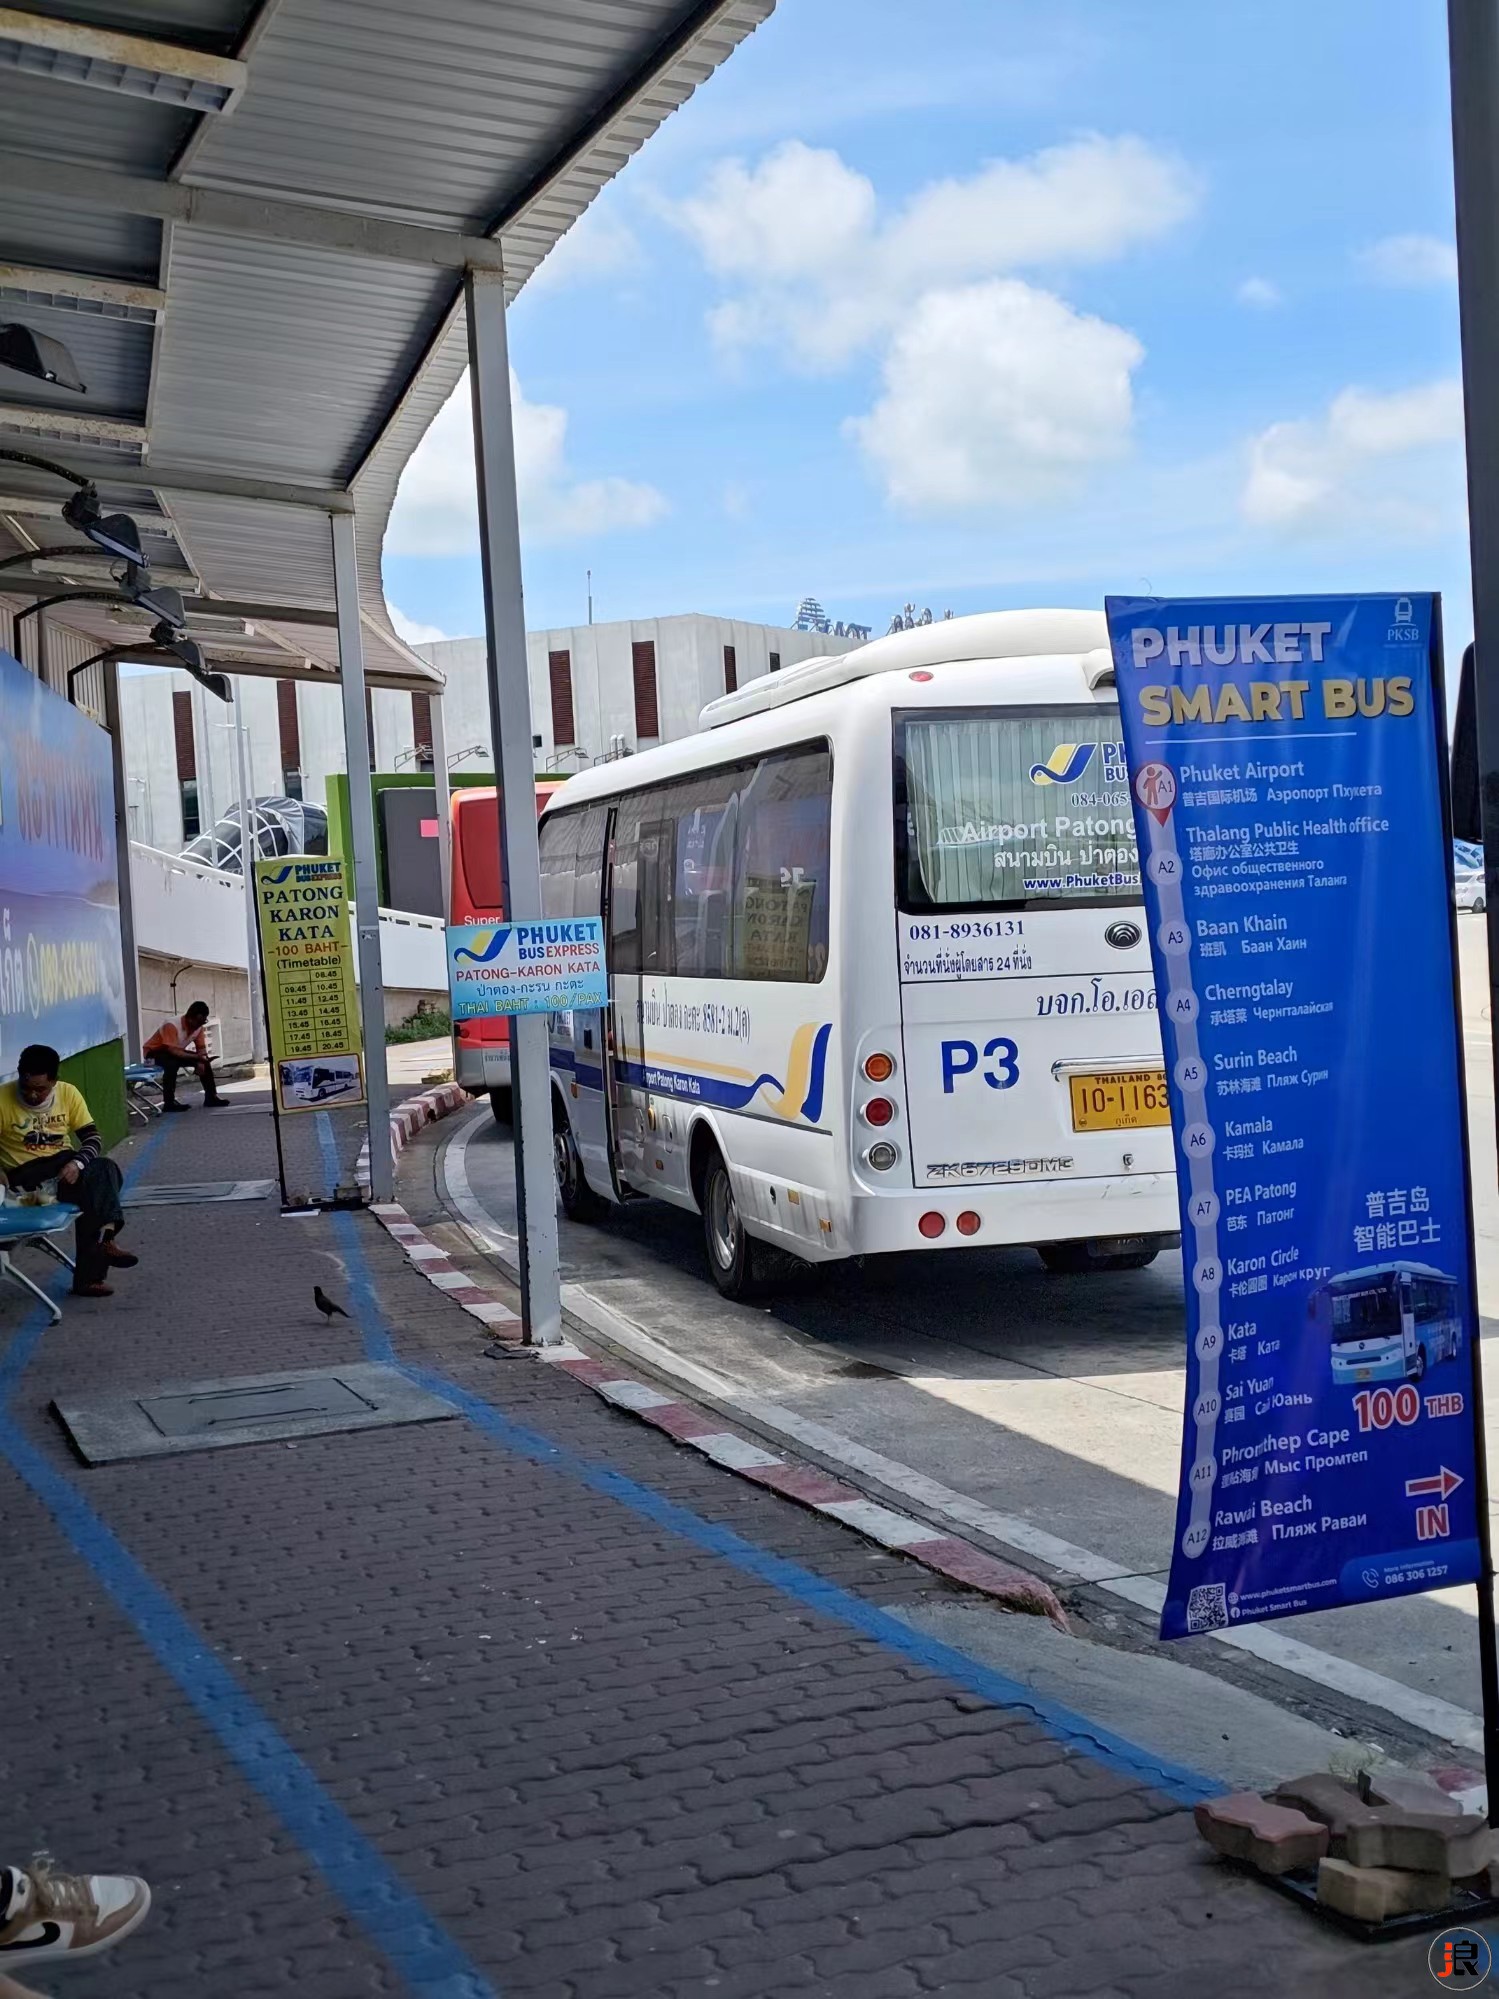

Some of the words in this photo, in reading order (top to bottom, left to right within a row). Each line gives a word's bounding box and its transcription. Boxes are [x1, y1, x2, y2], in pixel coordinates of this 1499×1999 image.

[1387, 628, 1419, 641] PKSB
[1130, 622, 1332, 668] PHUKET
[1138, 680, 1311, 726] SMART
[1322, 676, 1415, 718] BUS
[1180, 764, 1240, 783] Phuket
[1245, 761, 1305, 783] Airport
[1158, 780, 1173, 793] A1
[1182, 788, 1258, 807] 普吉国际机场
[1267, 786, 1329, 804] Аэропорт
[1332, 783, 1383, 801] Пхукета
[962, 818, 1048, 845] Airport
[1186, 825, 1250, 844] Thalang
[1254, 820, 1299, 838] Public
[1302, 818, 1348, 835] Health
[1349, 817, 1390, 833] office
[993, 843, 1072, 869] สนามบิน
[294, 862, 341, 875] PHUKET
[1158, 860, 1175, 874] A2
[1191, 864, 1229, 880] Офис
[1231, 860, 1324, 876] общественного
[1024, 872, 1142, 889] www.PhuketBus
[1194, 879, 1305, 898] здравоохранения
[262, 886, 343, 905] PATONG
[269, 905, 339, 923] KARON
[278, 925, 335, 941] KATA
[517, 922, 597, 946] PHUKET
[909, 920, 1024, 940] 081-8936131
[1196, 919, 1239, 937] Baan
[1243, 913, 1288, 933] Khain
[1168, 930, 1184, 944] A3
[1241, 940, 1274, 954] Баан
[1276, 936, 1307, 951] Хаин
[518, 947, 545, 960] BUS
[546, 943, 600, 958] EXPRESS
[277, 955, 341, 969] (Timetable)
[567, 961, 600, 974] KATA
[997, 957, 1010, 971] 24
[317, 983, 338, 991] 10.45
[1205, 979, 1294, 1001] Cherngtalay
[459, 1002, 489, 1015] THAI
[495, 998, 529, 1012] BAHT
[1176, 999, 1191, 1012] A4
[941, 1037, 1019, 1093] P3
[1213, 1051, 1254, 1071] Surin
[1257, 1045, 1298, 1066] Beach
[657, 1070, 674, 1093] Patong
[673, 1074, 689, 1092] Karon
[688, 1076, 701, 1095] Kata
[1094, 1074, 1151, 1085] THAILAND
[1183, 1067, 1198, 1080] A5
[1266, 1074, 1299, 1088] Пляж
[1082, 1083, 1169, 1114] 10-1163
[1225, 1115, 1273, 1137] Kamala
[1190, 1133, 1207, 1147] A6
[1262, 1137, 1304, 1155] Камала
[1225, 1186, 1253, 1206] PEA
[1254, 1181, 1297, 1200] Patong
[1365, 1185, 1430, 1219] 普吉岛
[1196, 1201, 1211, 1215] A7
[1257, 1207, 1295, 1226] Патонг
[1353, 1216, 1441, 1253] 智能巴士
[1227, 1256, 1266, 1276] Karon
[1270, 1245, 1299, 1267] Circle
[1201, 1267, 1215, 1281] A8
[1299, 1266, 1331, 1281] круг
[1228, 1321, 1257, 1341] Kata
[1202, 1335, 1216, 1350] A9
[1257, 1339, 1280, 1356] Ката
[1225, 1381, 1244, 1401] Sai
[1247, 1376, 1274, 1395] Yuan
[1198, 1398, 1217, 1416] A10
[1271, 1393, 1313, 1408] Юань
[1352, 1384, 1420, 1433] 100
[1424, 1392, 1464, 1419] THB
[1306, 1428, 1350, 1448] Cape
[1264, 1459, 1301, 1475] Мыс
[1305, 1450, 1368, 1472] Промтеп
[1194, 1465, 1211, 1480] A11
[1214, 1501, 1256, 1527] Rawai
[1260, 1494, 1313, 1517] Beach
[1271, 1523, 1317, 1541] Пляж
[1321, 1513, 1367, 1532] Раваи
[1416, 1504, 1450, 1541] IN
[1186, 1528, 1208, 1545] A12
[1385, 1573, 1405, 1585] 086
[1406, 1569, 1425, 1581] 306
[1426, 1565, 1448, 1577] 1257
[1240, 1578, 1338, 1600] www.phuketsmartbus.com
[1241, 1606, 1269, 1616] Phuket
[1269, 1602, 1292, 1612] Smart
[1293, 1599, 1308, 1608] Bus
